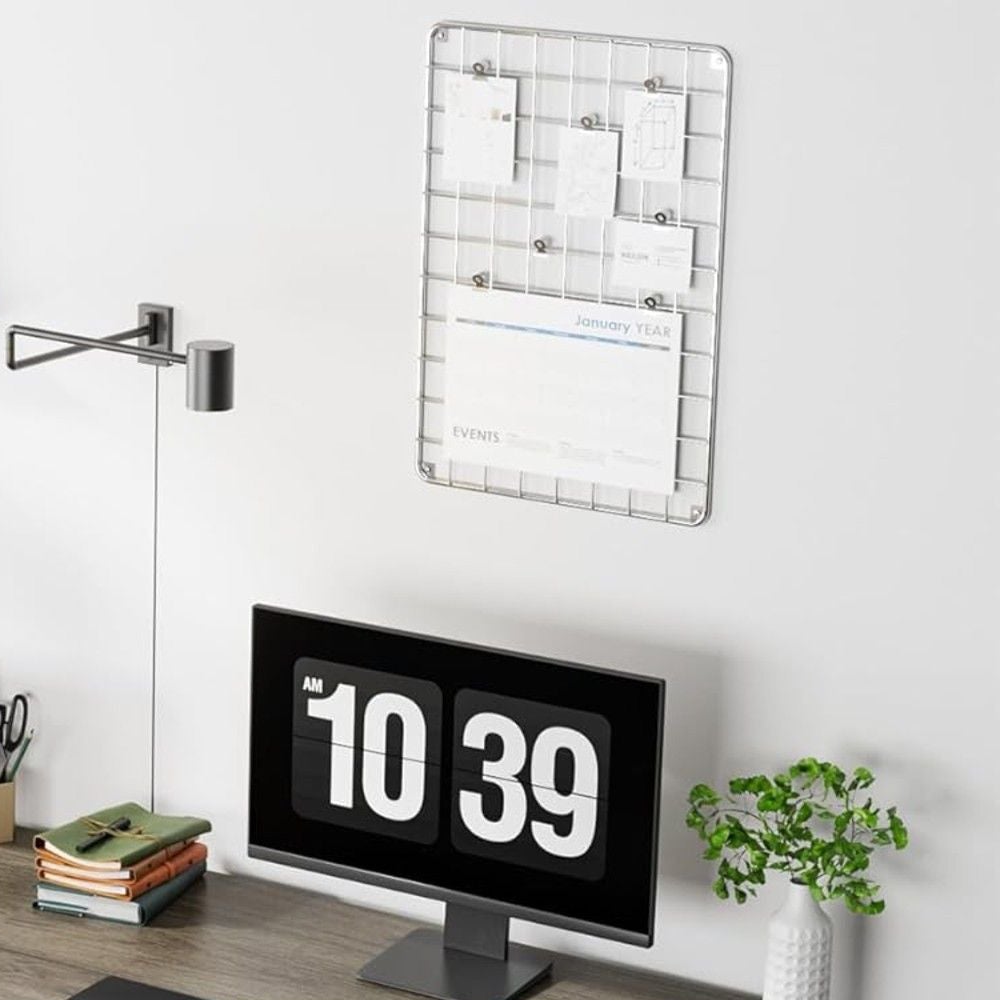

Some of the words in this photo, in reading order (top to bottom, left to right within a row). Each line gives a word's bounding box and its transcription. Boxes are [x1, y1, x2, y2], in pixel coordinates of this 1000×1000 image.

[575, 314, 631, 334] January
[635, 322, 671, 338] YEAR
[453, 426, 500, 443] EVENTS
[303, 676, 323, 694] AM
[307, 683, 427, 822] 10
[459, 712, 599, 859] 39
